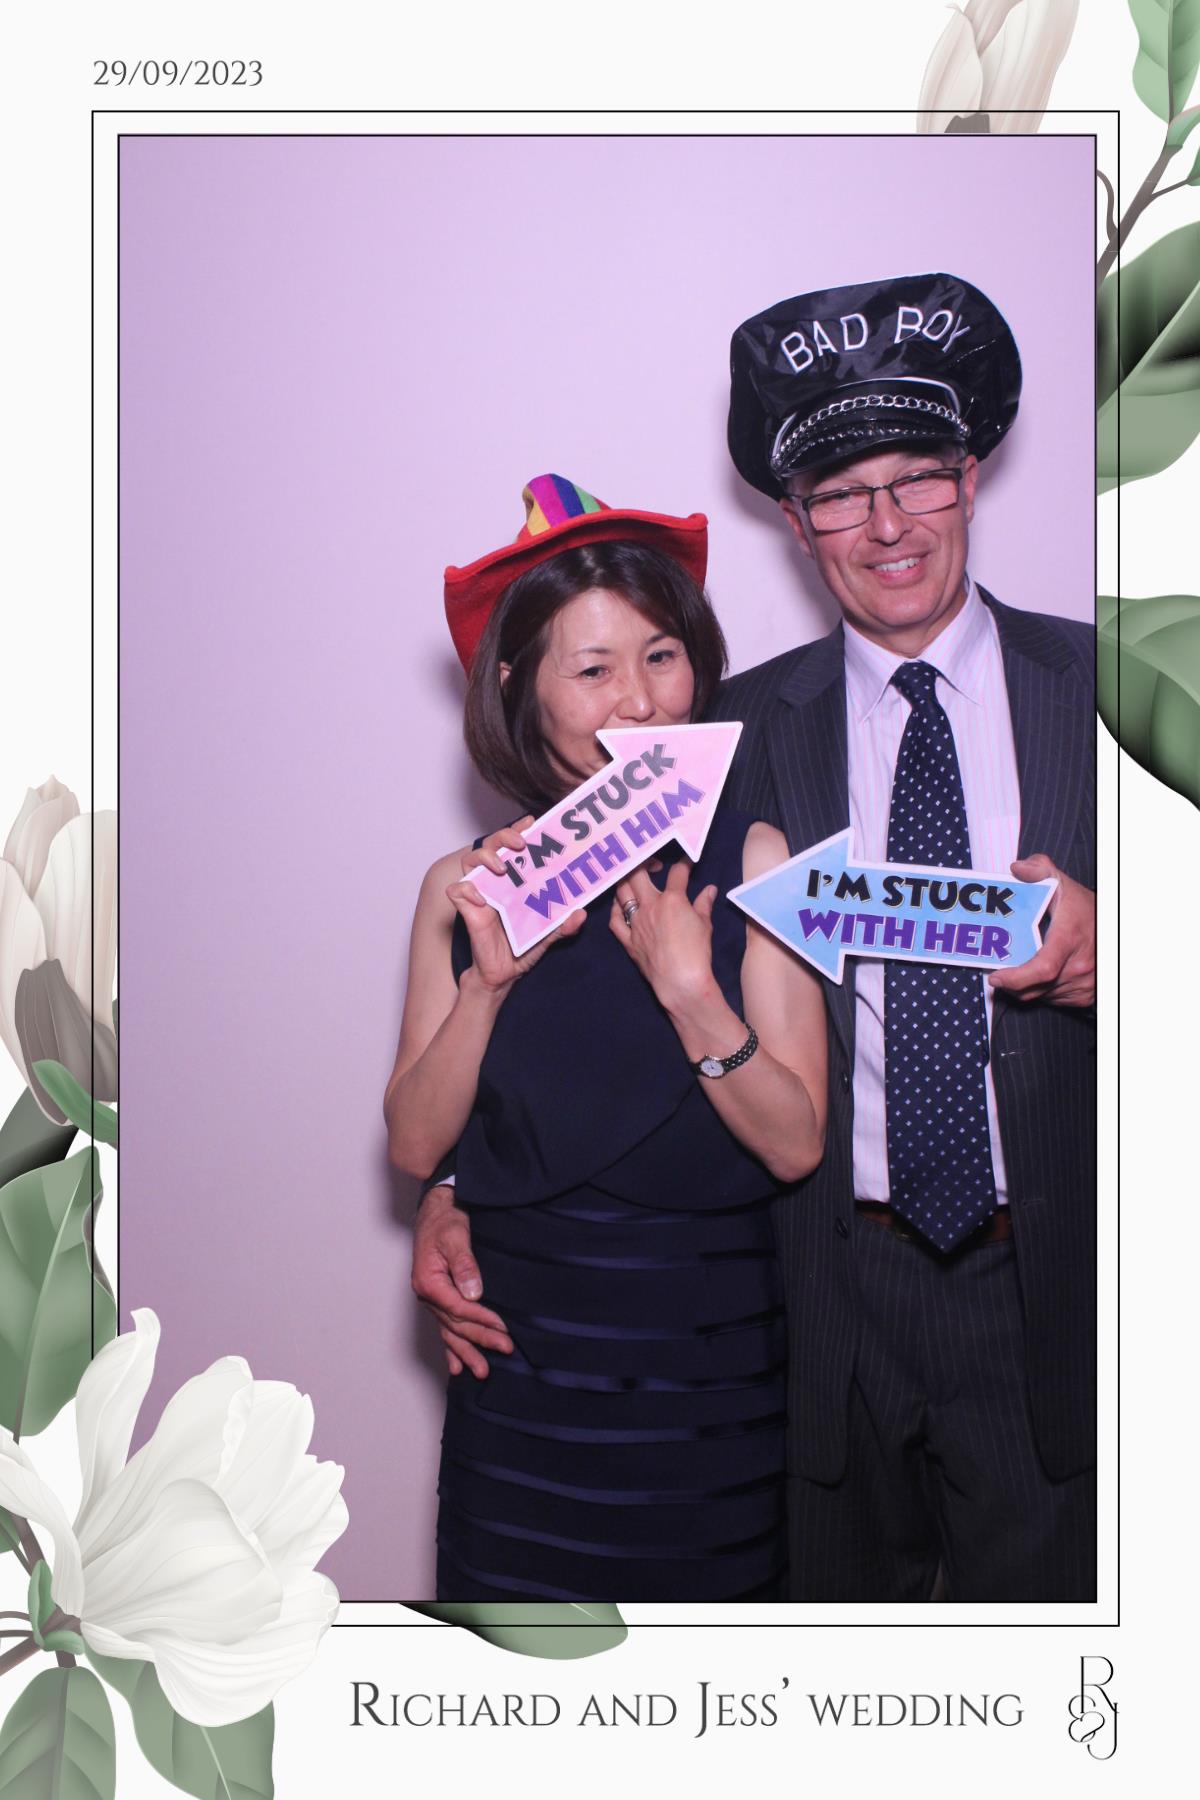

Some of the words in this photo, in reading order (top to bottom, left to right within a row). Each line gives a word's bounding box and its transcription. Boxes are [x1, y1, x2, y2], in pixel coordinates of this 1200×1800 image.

[780, 313, 869, 374] BAD
[894, 306, 970, 352] BOY
[504, 831, 564, 888] I’M
[561, 744, 678, 841] STUCK
[524, 832, 630, 920] WITH
[620, 778, 706, 848] HIM
[806, 869, 872, 902] I’M
[882, 875, 1016, 917] STUCK
[798, 908, 916, 951] WITH
[924, 920, 1010, 960] HER
